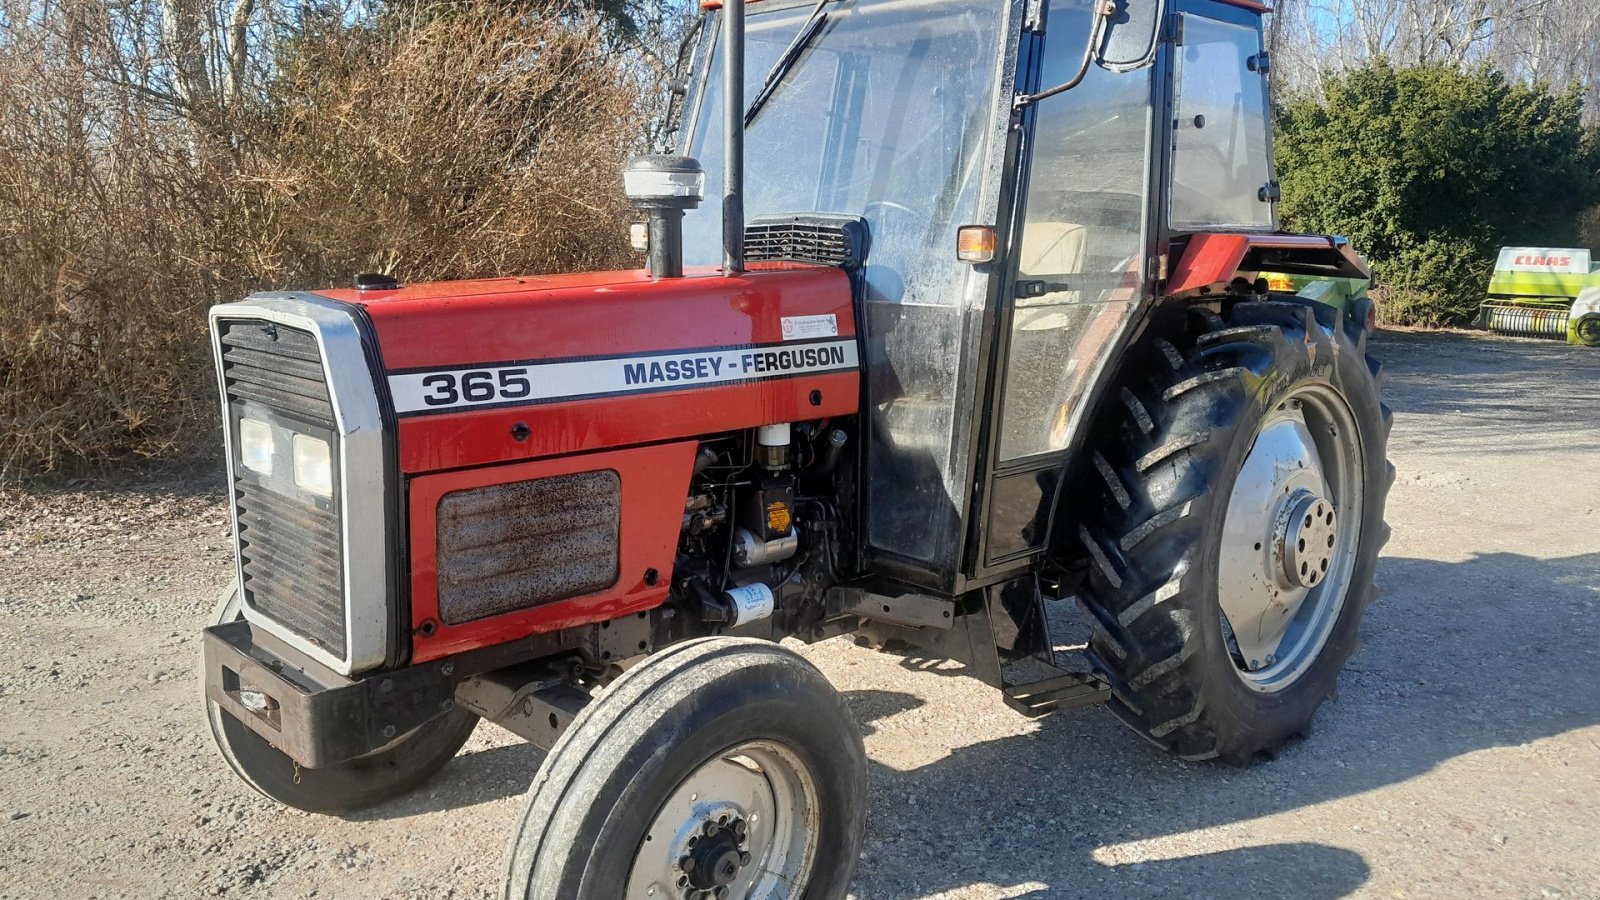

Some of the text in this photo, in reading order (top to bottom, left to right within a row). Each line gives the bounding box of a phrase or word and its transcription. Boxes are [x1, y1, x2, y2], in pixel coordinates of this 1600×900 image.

[1514, 255, 1571, 267] CLAAS
[623, 356, 722, 385] MASSEY
[741, 346, 845, 373] FERGUSON
[422, 368, 531, 406] 365
